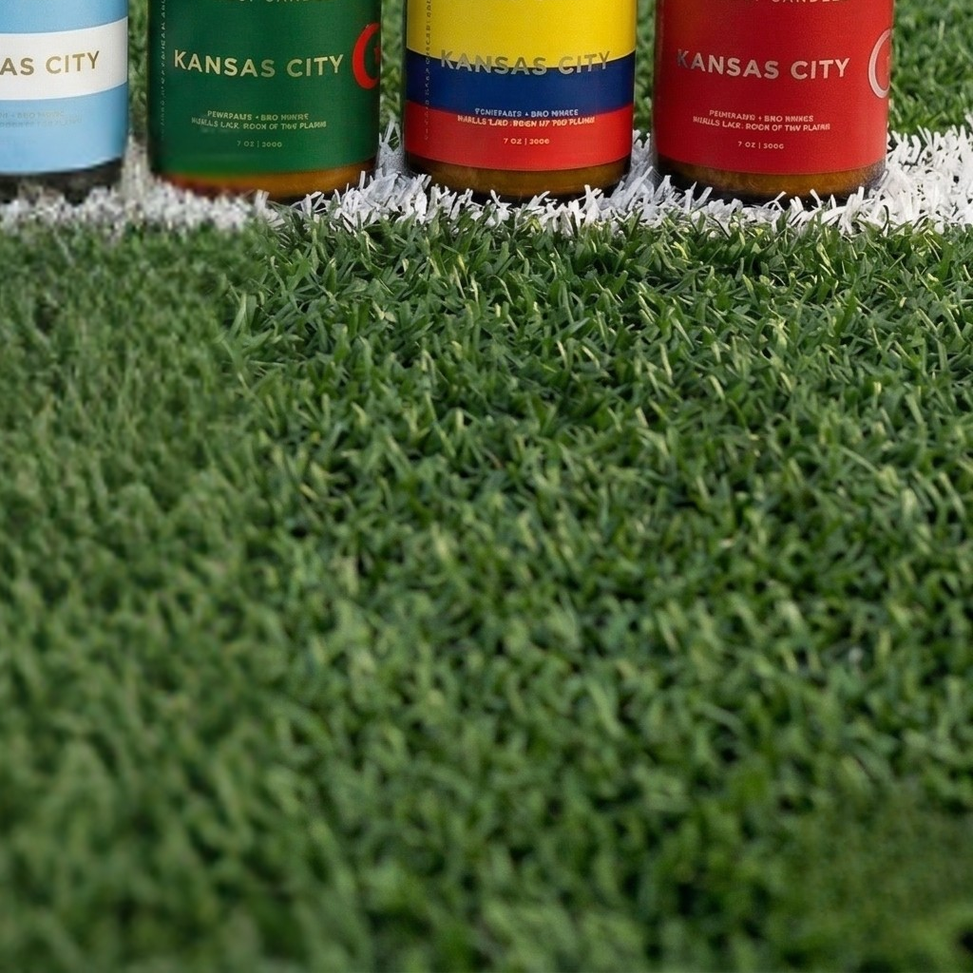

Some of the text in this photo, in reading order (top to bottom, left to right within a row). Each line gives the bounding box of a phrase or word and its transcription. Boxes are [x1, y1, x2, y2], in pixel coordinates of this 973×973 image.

[46, 51, 99, 74] CITY
[174, 50, 343, 77] KANSAS CITY
[441, 50, 610, 75] KANSAS CITY
[678, 49, 850, 79] KANSAS CITY
